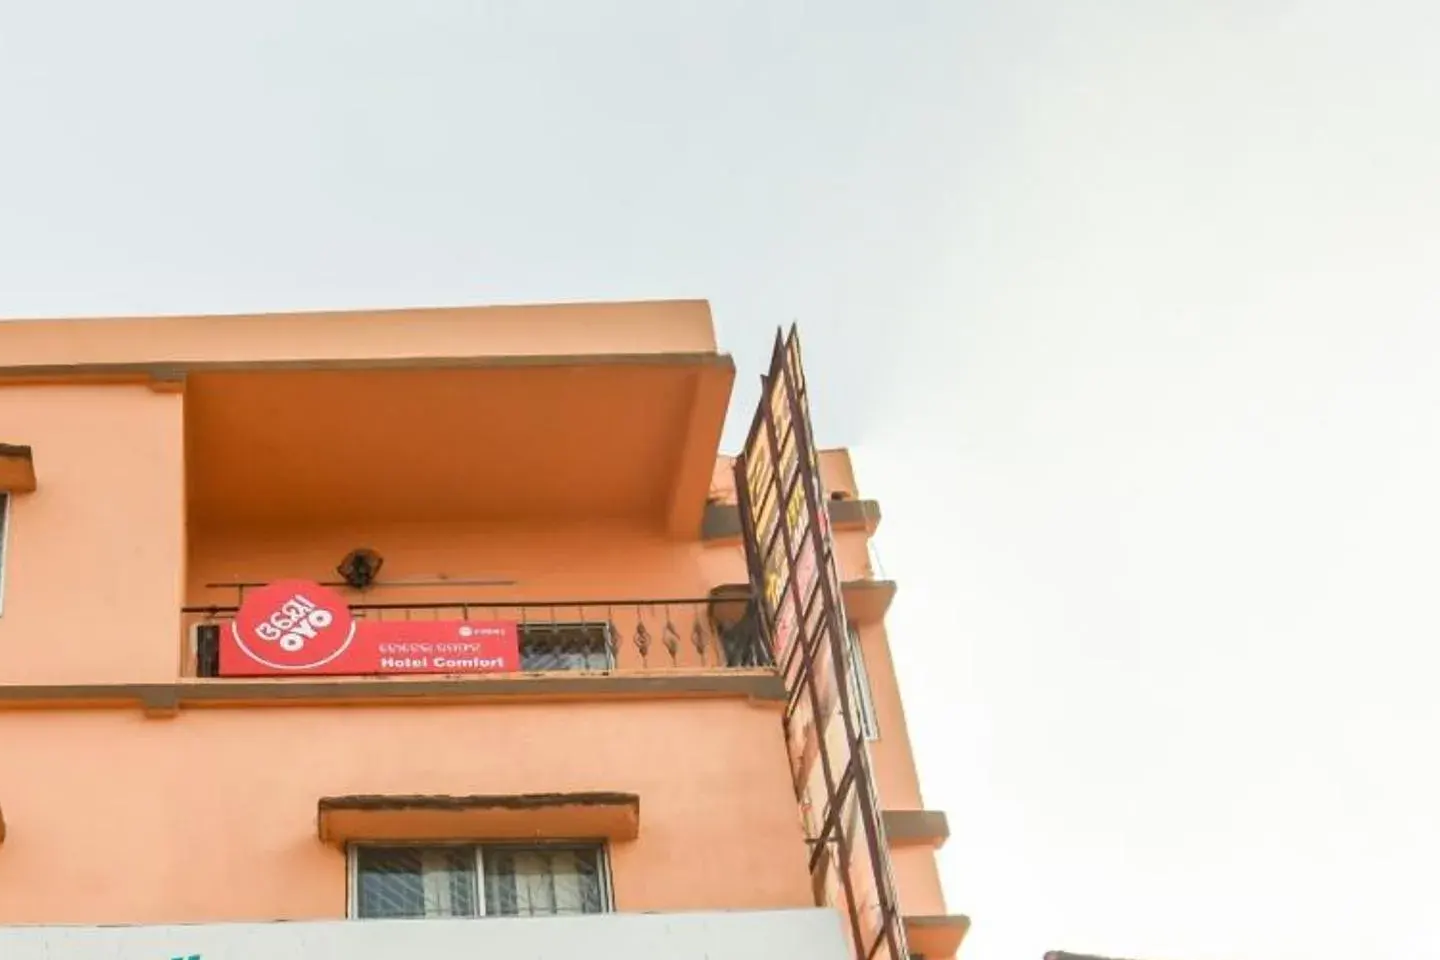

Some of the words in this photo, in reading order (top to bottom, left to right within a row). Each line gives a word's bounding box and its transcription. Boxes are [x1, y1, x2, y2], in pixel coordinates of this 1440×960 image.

[280, 610, 333, 652] OYO
[381, 657, 427, 668] Hotel
[433, 656, 504, 668] Comfort
